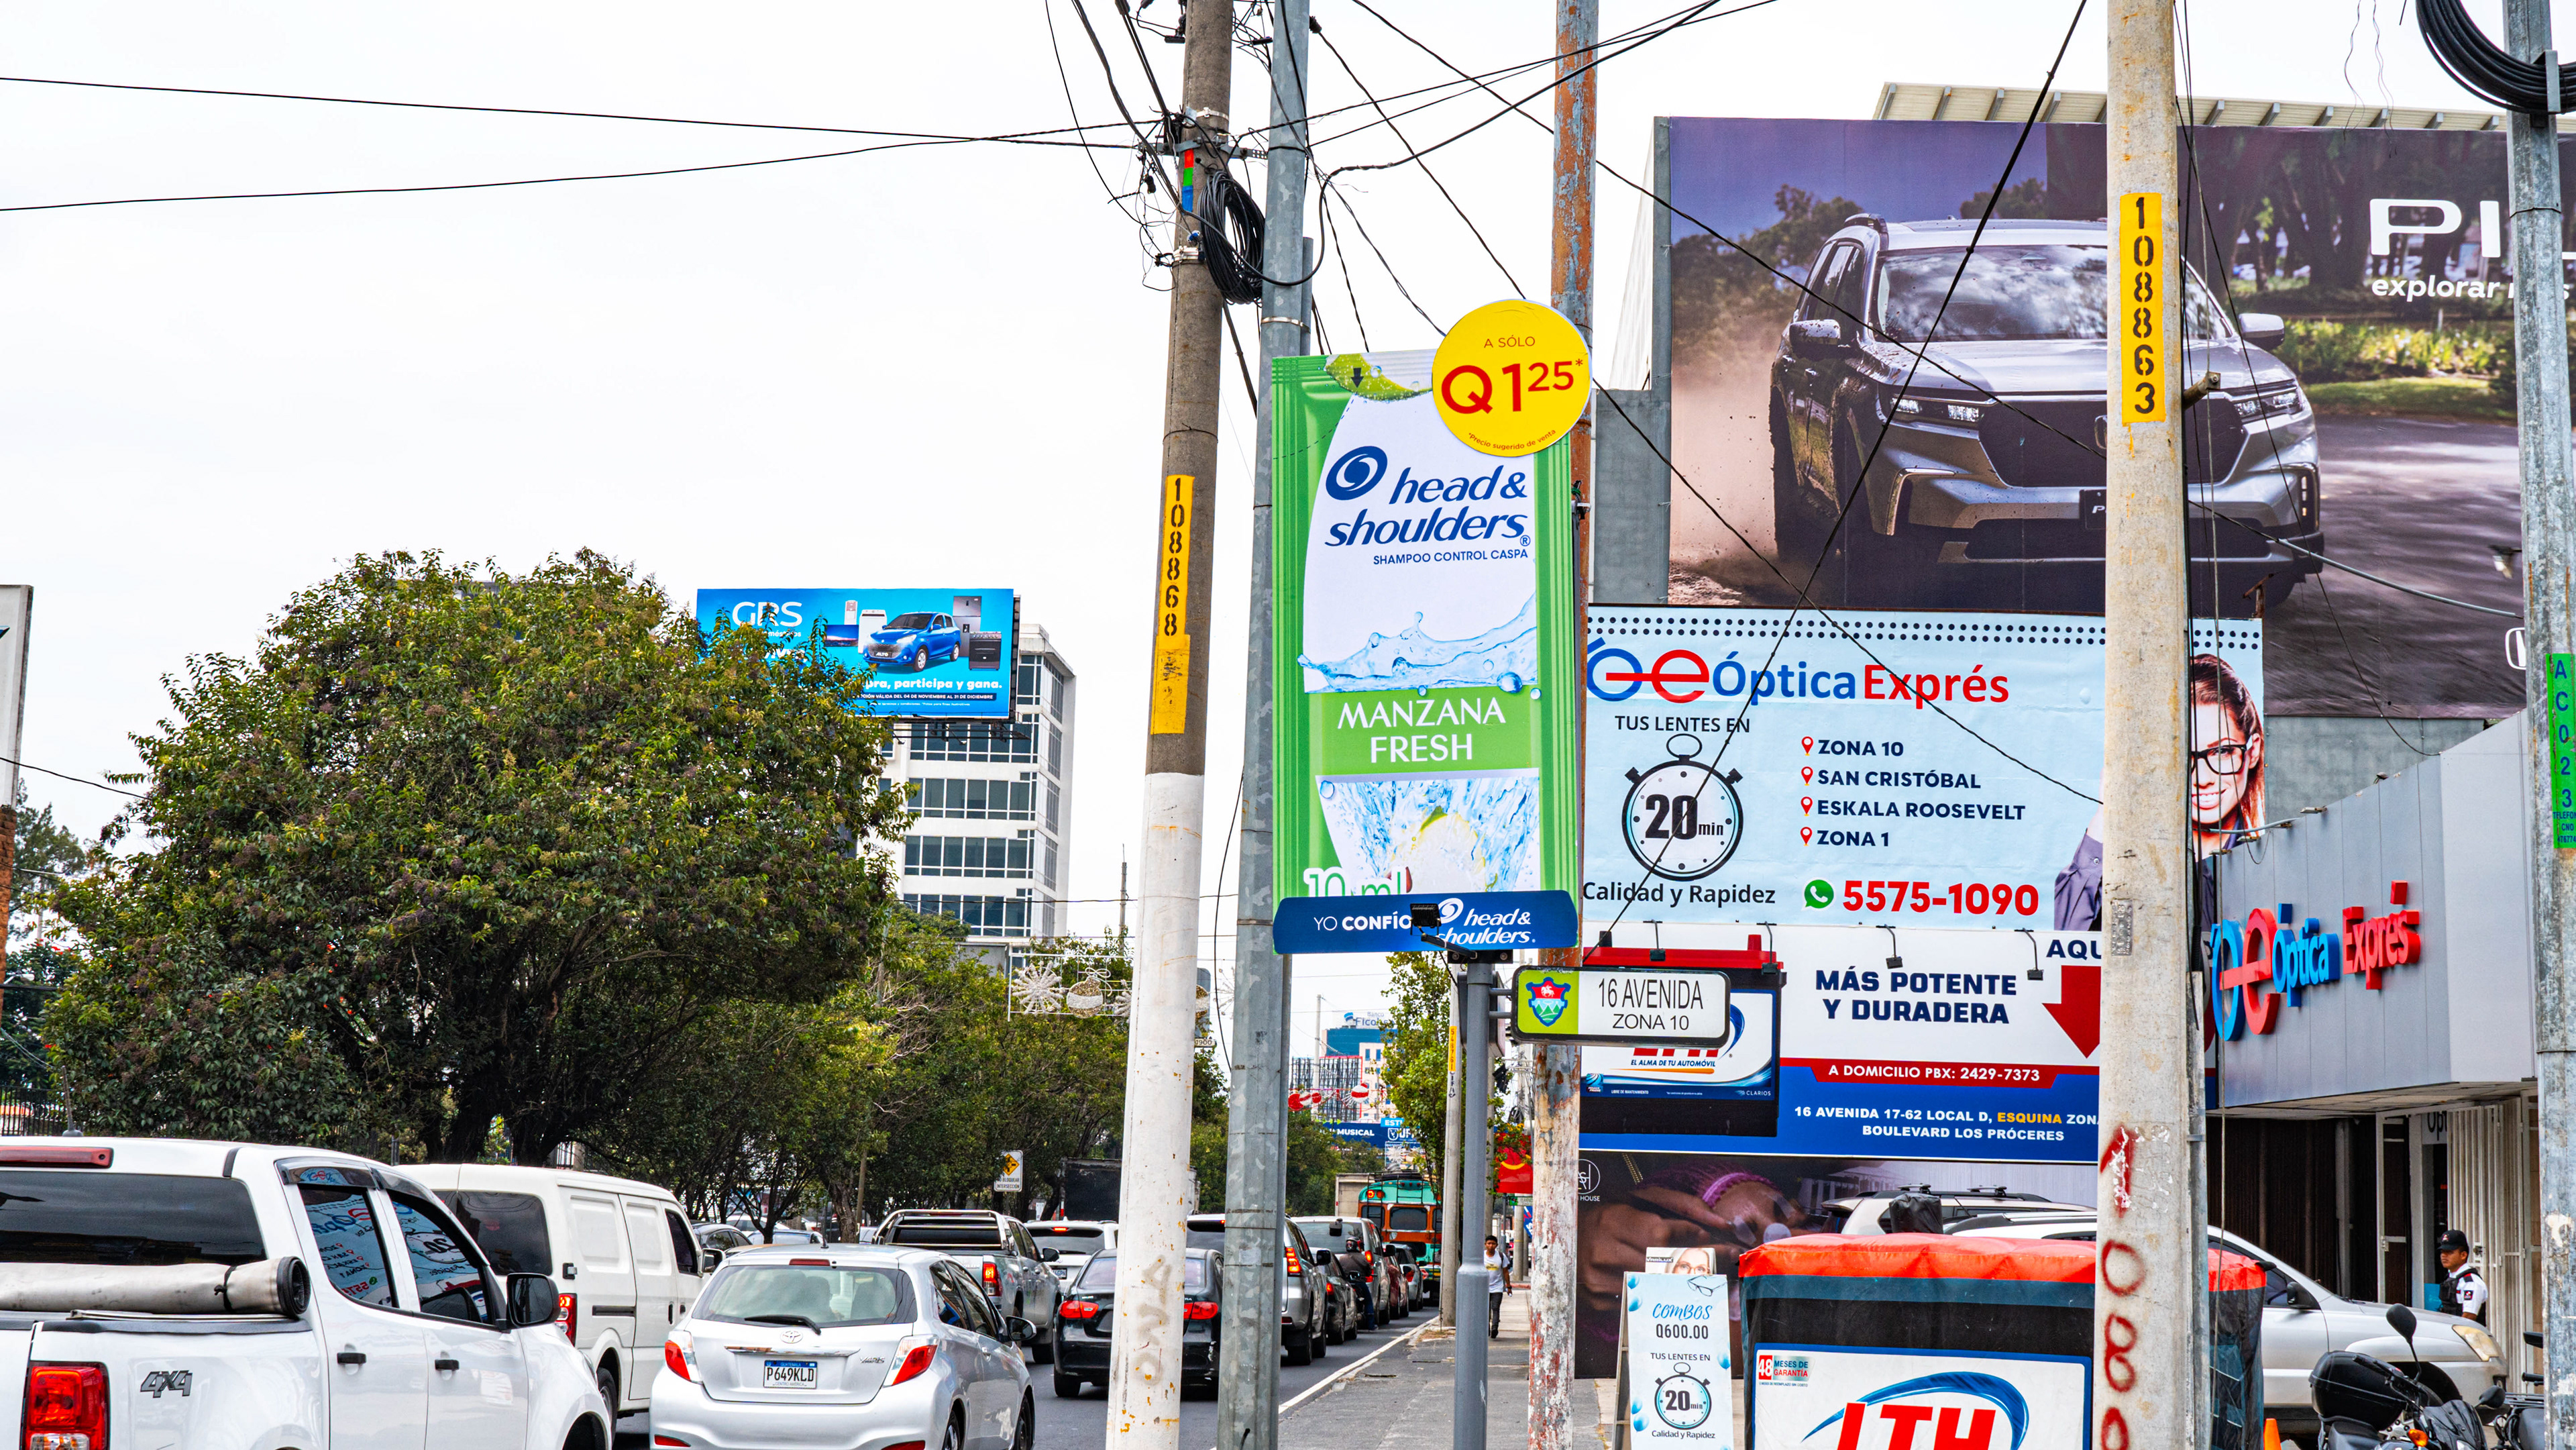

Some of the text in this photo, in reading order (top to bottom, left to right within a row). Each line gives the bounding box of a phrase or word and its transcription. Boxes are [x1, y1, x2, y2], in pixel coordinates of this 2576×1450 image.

[2371, 275, 2500, 302] explorar
[2133, 197, 2155, 414] 108863
[1484, 335, 1536, 348] A SÓLO
[1537, 429, 1556, 442] venta
[1164, 478, 1184, 636] 108868
[1373, 548, 1528, 565] SHAMPOO CONTROL CASPA
[733, 601, 802, 627] GRS
[894, 678, 953, 690] participa
[956, 681, 963, 690] y
[967, 681, 1002, 690] gana.
[1713, 651, 2009, 709] Óptica Exprés
[1338, 697, 1506, 729] MANZANA
[1615, 715, 1750, 733] TUS LENTES EN
[1371, 734, 1472, 763] FRESH
[1818, 739, 1904, 756] ZONA 10
[1817, 768, 1981, 789] SAN CRISTÓBAL
[1817, 800, 2025, 820] ESKALA ROOSEVELT
[1817, 830, 1889, 847] ZONA 1
[1582, 882, 1775, 907] Calidad y Rapidez
[1843, 880, 2039, 916] 5575-1090
[1313, 911, 1411, 931] YO CONFÍO
[2273, 880, 2420, 1007] Óptica Exprés
[1816, 966, 2017, 996] MÁS POTENTE
[1598, 978, 1703, 1009] 16 AVENIDA
[1823, 998, 2009, 1024] Y DURADERA
[1613, 1014, 1689, 1030] ZONA 10
[1677, 1059, 1715, 1067] AUTOMÓVIL
[1828, 1064, 2040, 1082] A DOMICILIO PBX: 2429-7373
[1794, 1106, 1811, 1117] 16
[1816, 1107, 1879, 1119] AVENIDA
[1884, 1109, 1922, 1120] 17-62
[1927, 1110, 1973, 1121] LOCAL
[1978, 1112, 1992, 1123] D,
[1997, 1112, 2062, 1124] ESQUINA
[1862, 1125, 2064, 1141] BOULEVARD LOS PRÓCERES
[1652, 1303, 1713, 1320] COMBOS
[1656, 1324, 1709, 1339] Q600.00
[1668, 1353, 1697, 1361] LENTES
[767, 1367, 814, 1382] P649KLD
[1758, 1359, 1772, 1376] 48
[1774, 1369, 1808, 1377] GARANTÍA
[1652, 1430, 1715, 1441] Calidad y Rapidez
